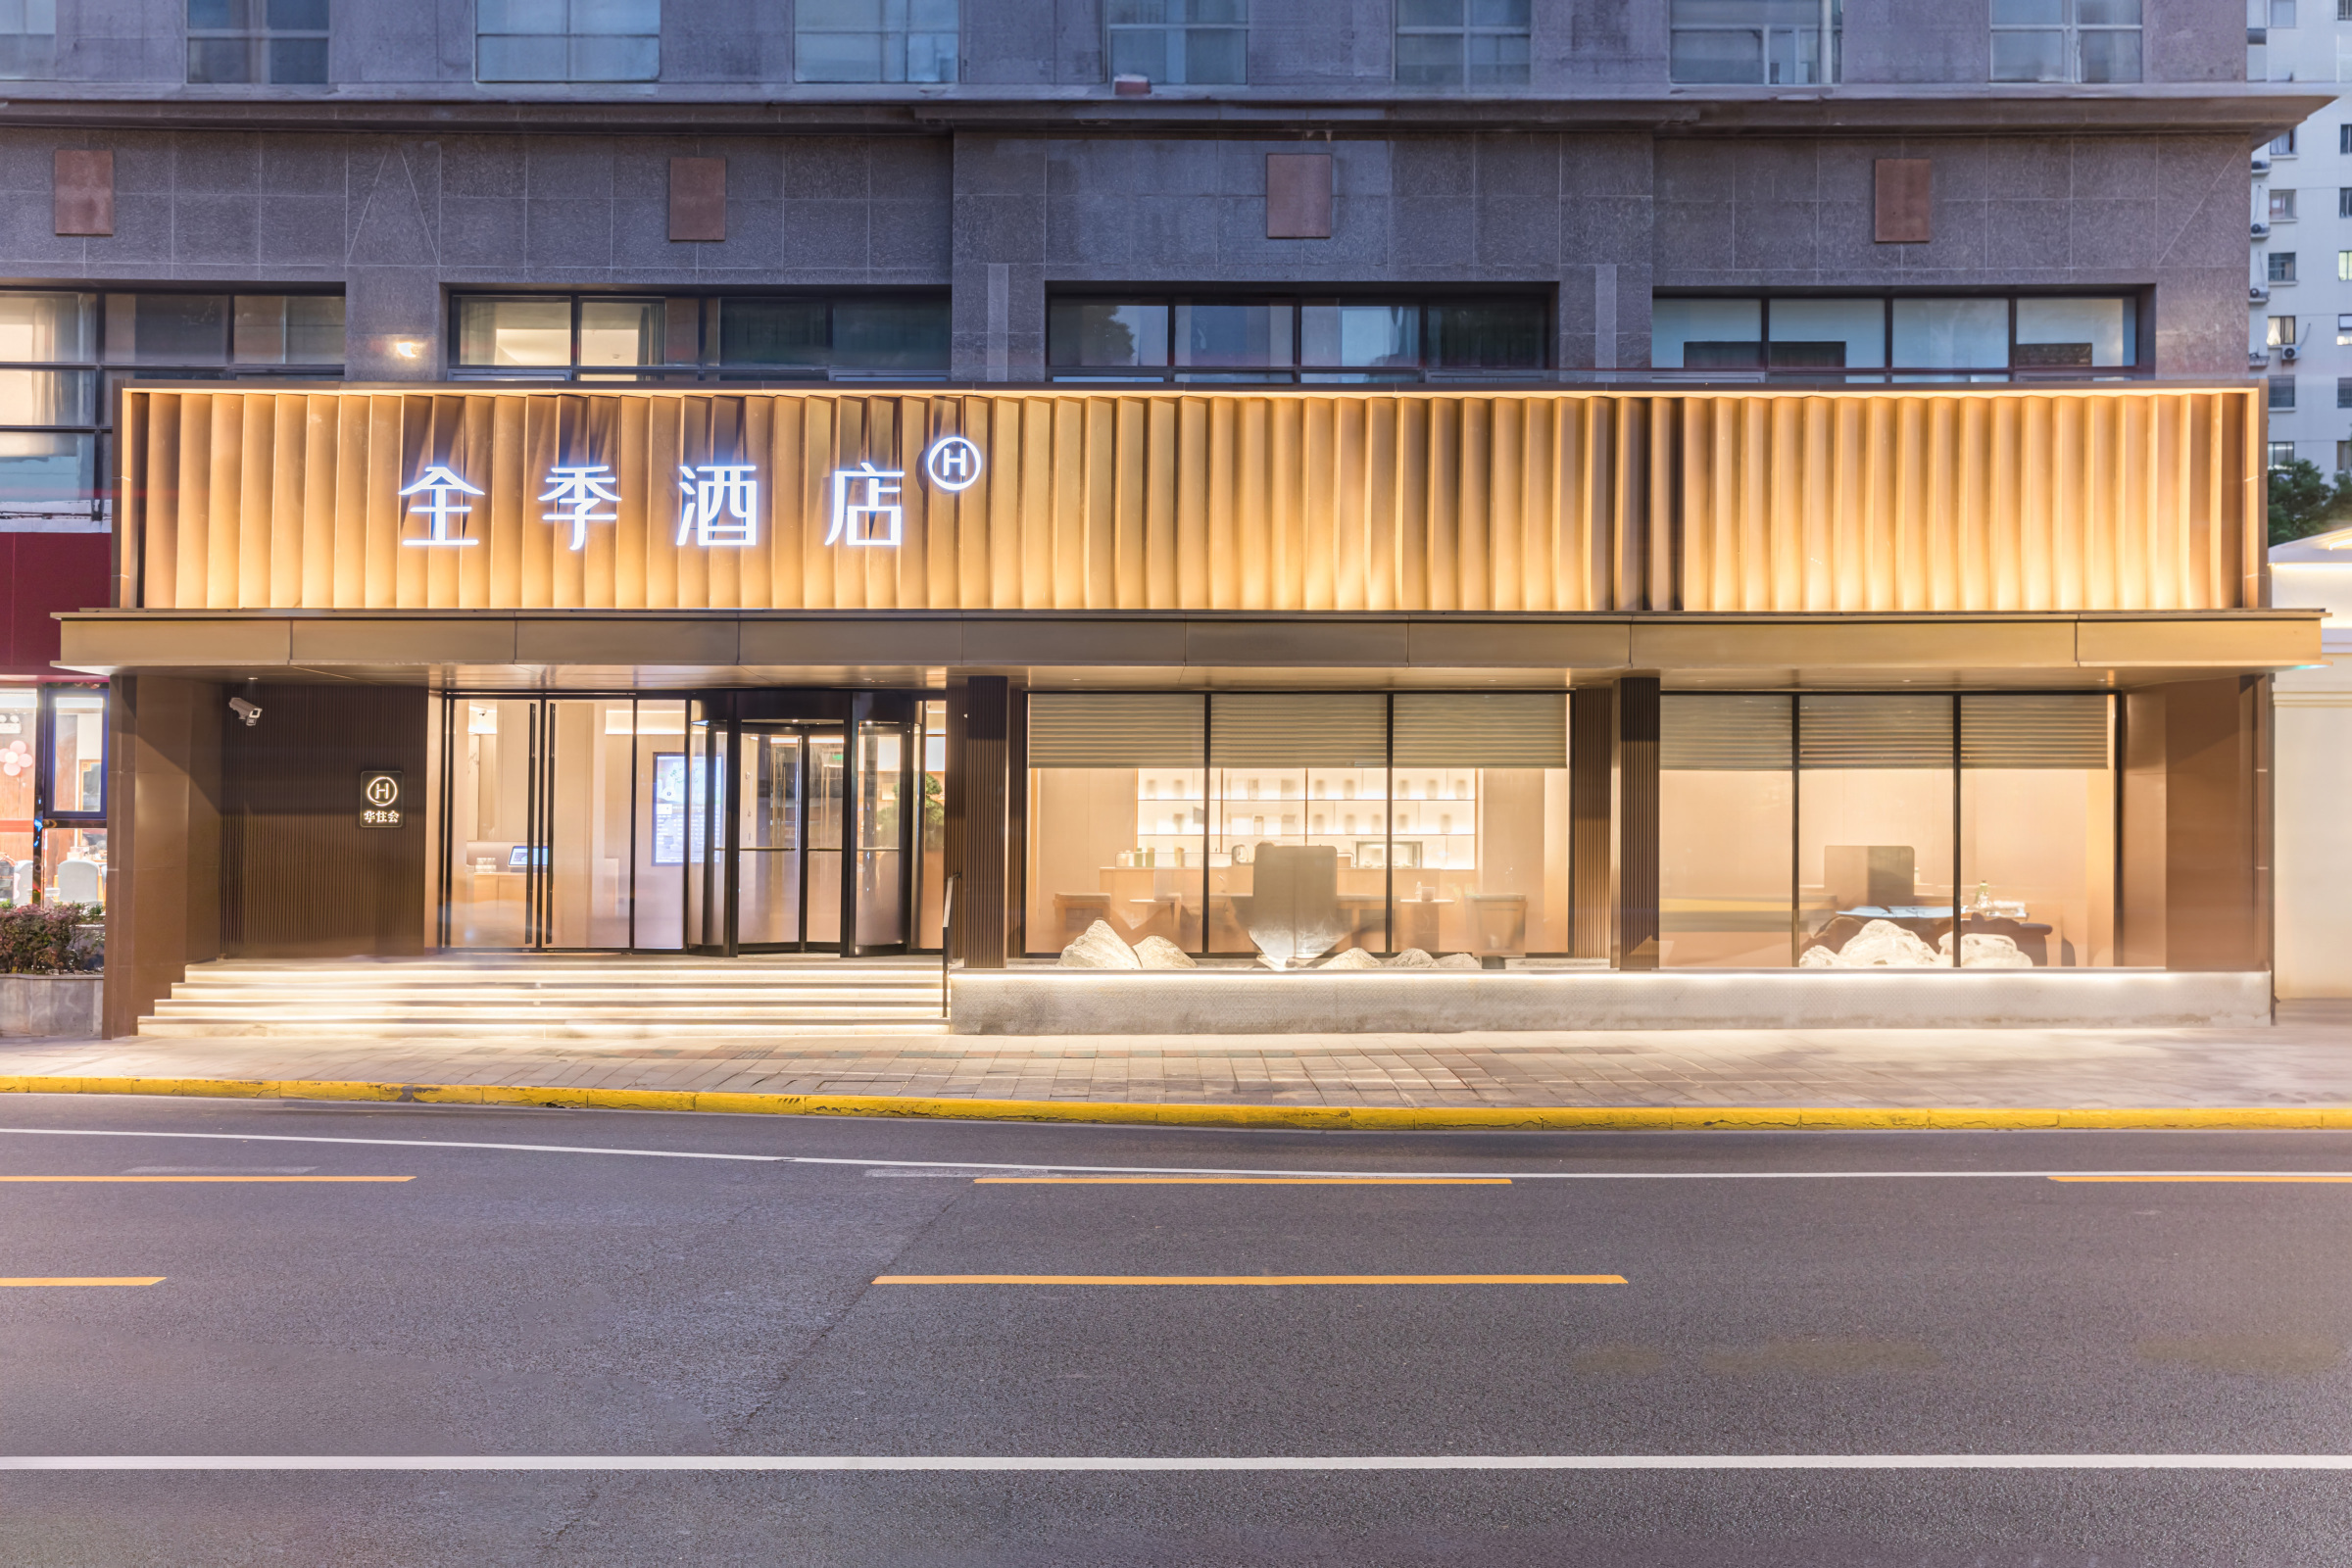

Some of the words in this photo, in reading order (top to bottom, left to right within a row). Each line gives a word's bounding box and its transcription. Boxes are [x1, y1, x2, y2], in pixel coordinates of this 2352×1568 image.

[397, 462, 906, 551] 全季酒店
[363, 809, 400, 823] 华住会
